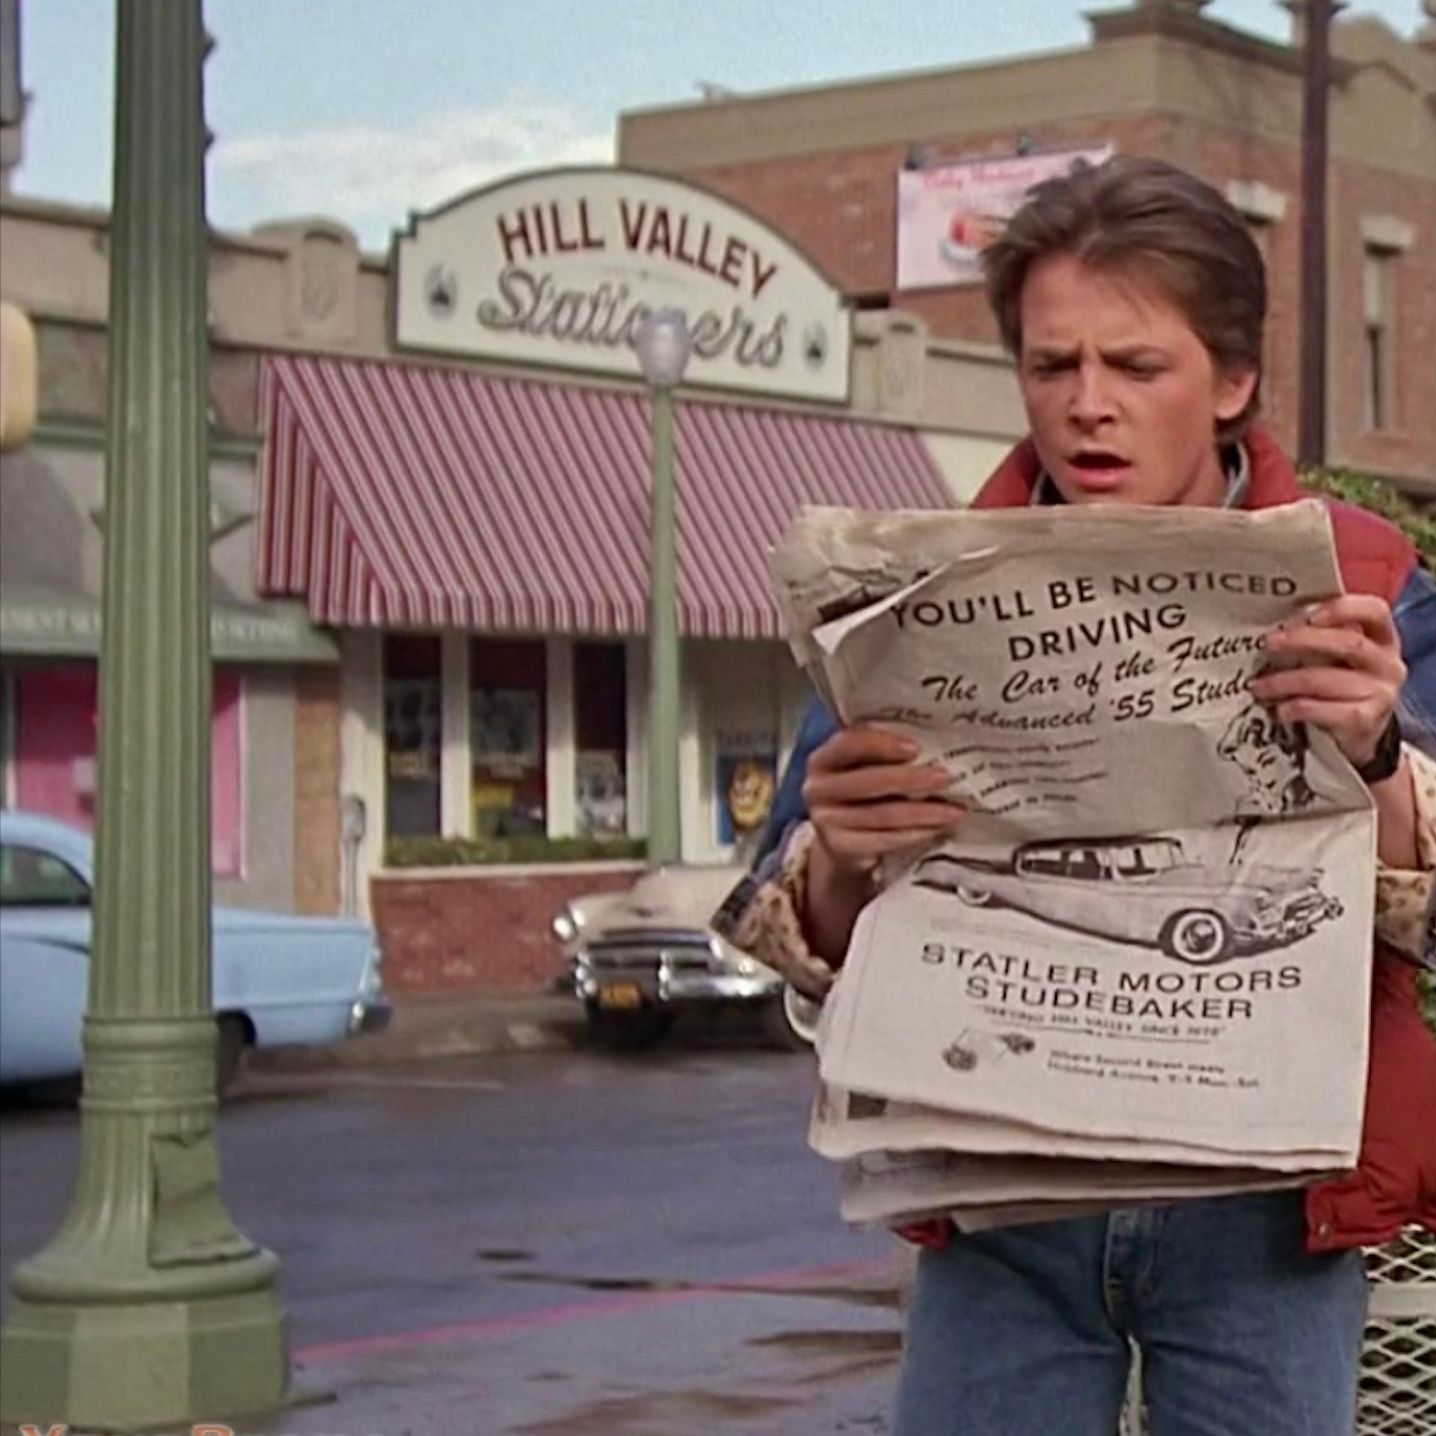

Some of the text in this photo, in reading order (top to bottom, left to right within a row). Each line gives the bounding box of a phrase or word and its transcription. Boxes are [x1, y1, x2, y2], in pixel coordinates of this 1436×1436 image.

[497, 197, 777, 300] HILL VALLEY
[476, 267, 787, 369] Statioers
[889, 572, 1297, 628] YOU'LL BE NOTICED
[1008, 603, 1187, 661] DRIVING
[921, 635, 1268, 703] The Car of the Future
[953, 704, 1095, 731] Advanced
[1109, 689, 1155, 721] '55
[921, 943, 1302, 993] STATLER MOTORS
[965, 975, 1253, 1019] STUDEBAKER
